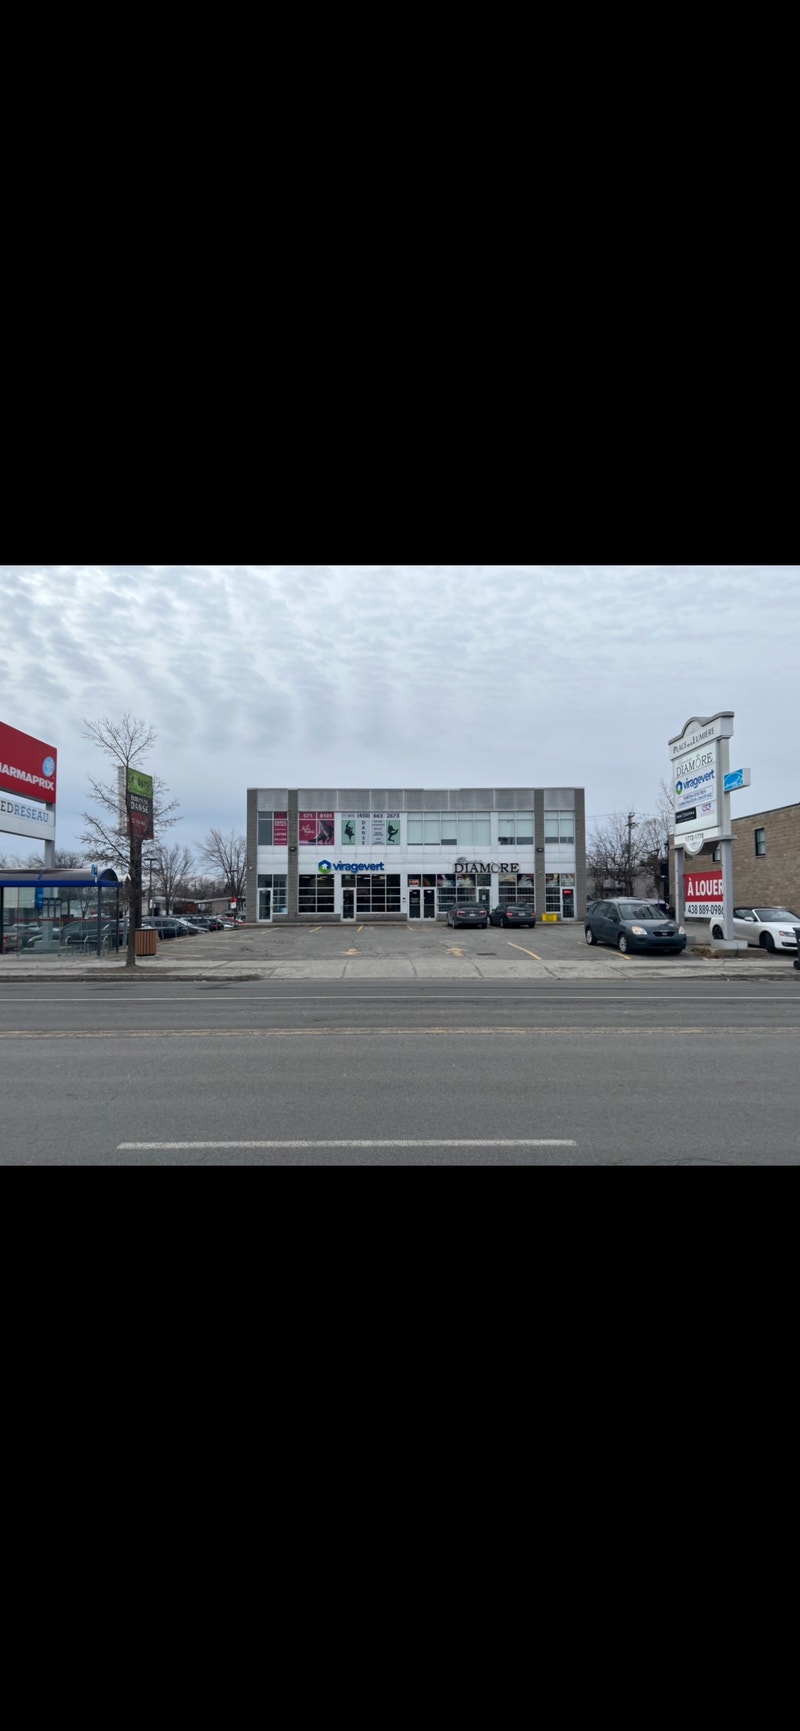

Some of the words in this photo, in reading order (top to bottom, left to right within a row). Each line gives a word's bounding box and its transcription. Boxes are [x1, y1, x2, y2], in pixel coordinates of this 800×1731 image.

[676, 752, 713, 777] DIAMORE
[682, 769, 715, 789] viragevert
[333, 860, 385, 873] viragevert
[454, 862, 520, 873] DIAMORE
[687, 877, 694, 896] À
[695, 879, 724, 896] LOUER
[688, 904, 698, 914] 438
